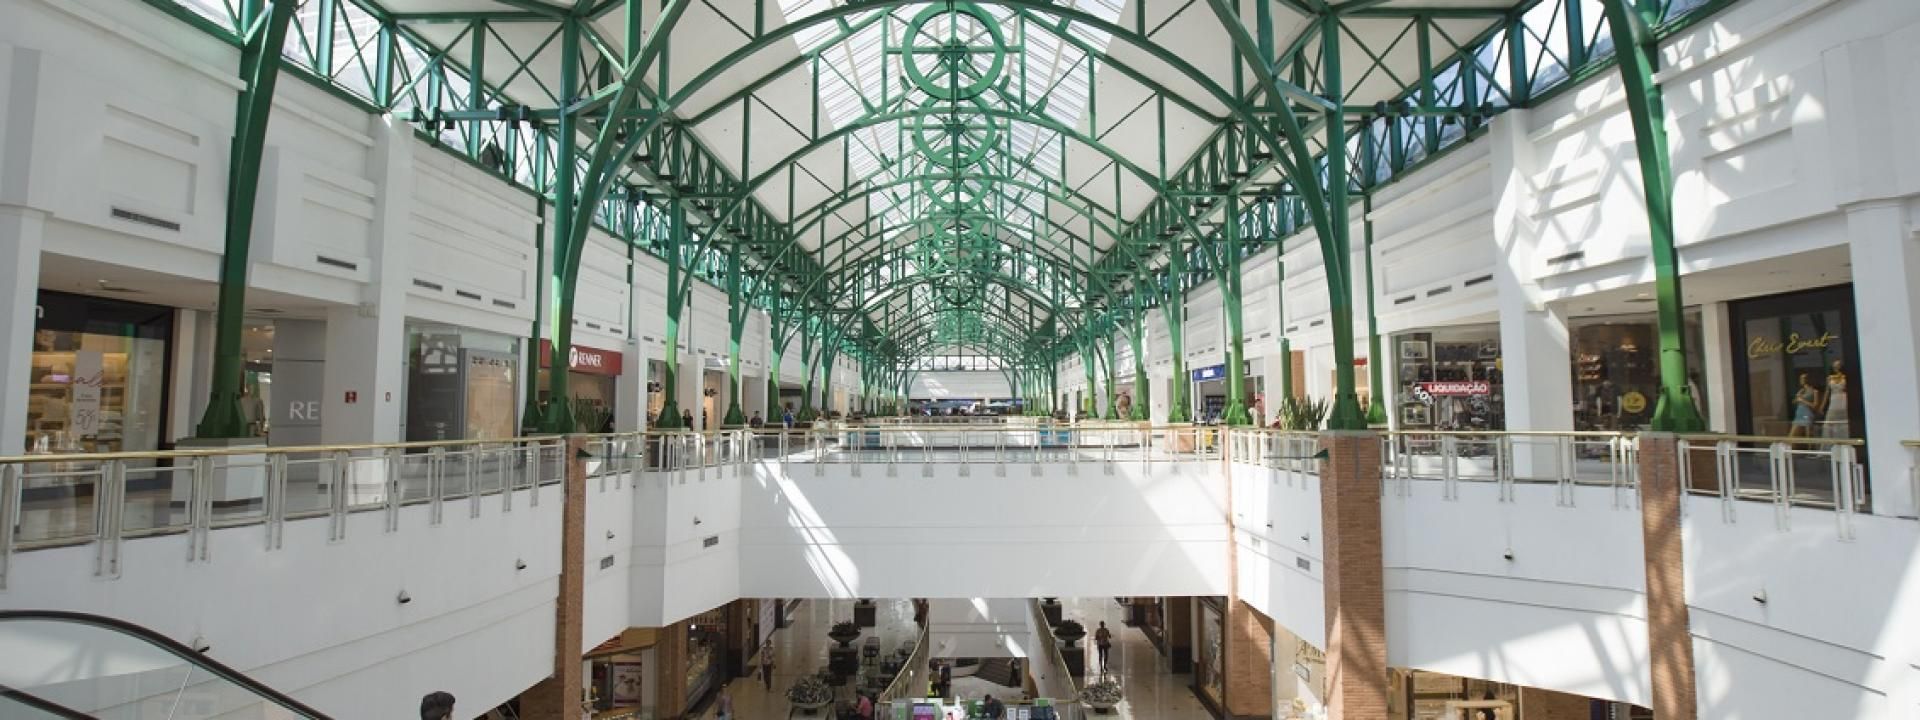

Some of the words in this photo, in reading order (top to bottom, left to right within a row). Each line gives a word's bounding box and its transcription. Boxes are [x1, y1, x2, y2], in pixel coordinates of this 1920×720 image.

[578, 351, 602, 367] RENNER
[1427, 381, 1487, 394] LIQUIDAÇÃO
[289, 401, 319, 420] RE
